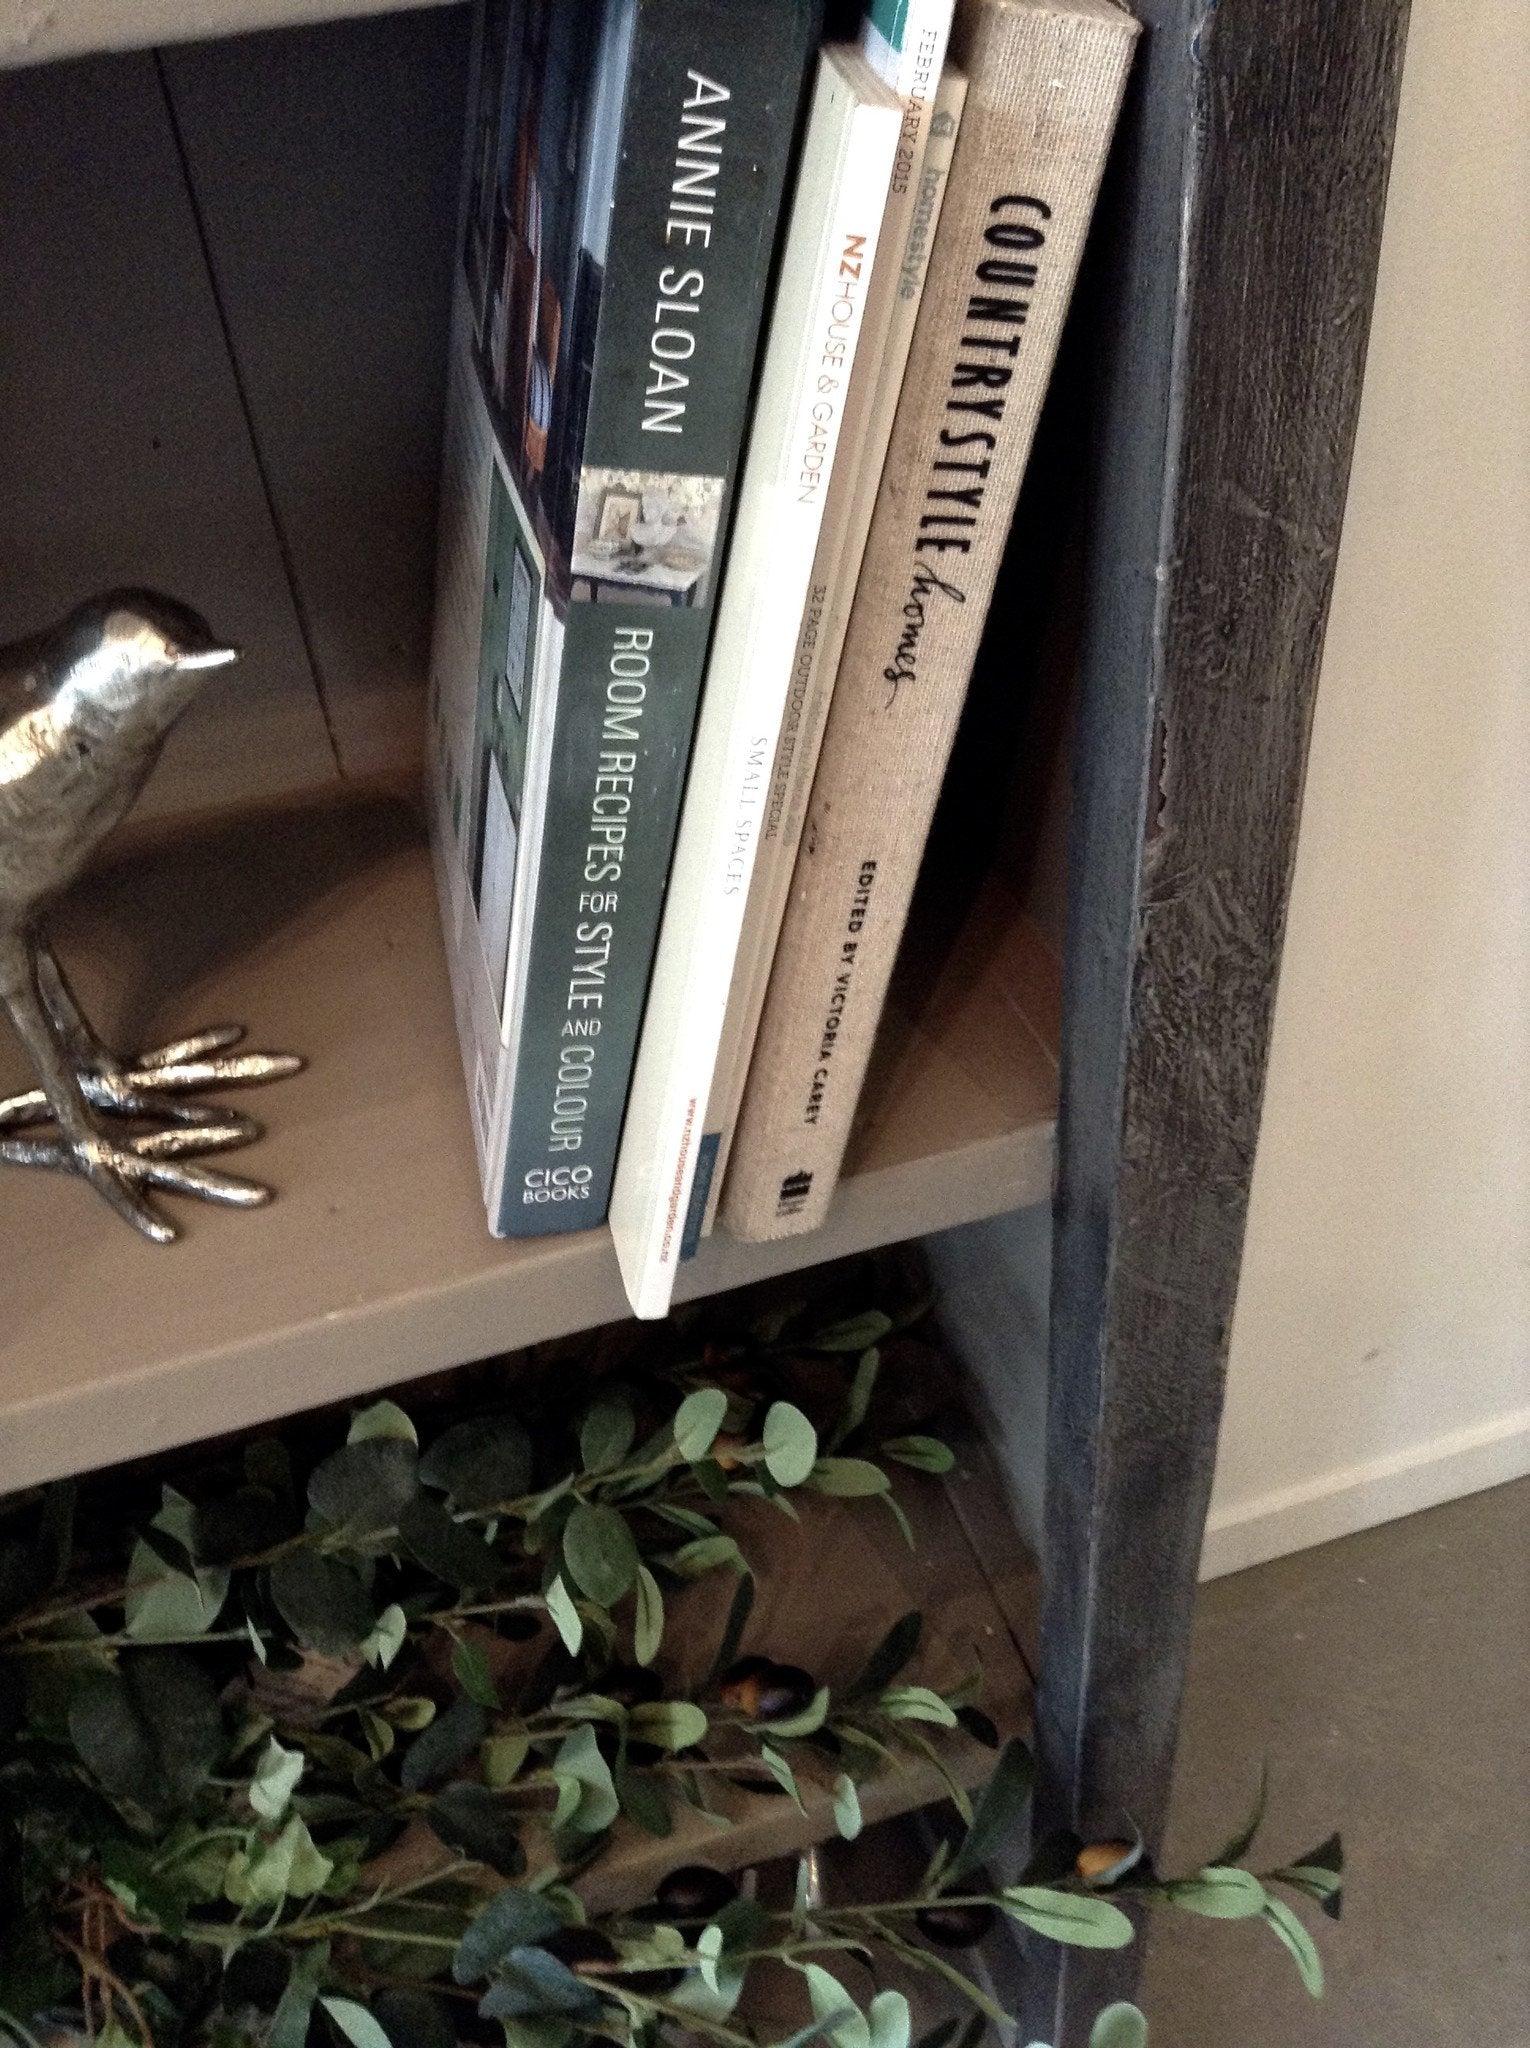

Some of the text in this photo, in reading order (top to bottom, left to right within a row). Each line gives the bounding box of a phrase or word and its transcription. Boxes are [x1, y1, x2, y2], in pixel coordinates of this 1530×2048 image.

[892, 28, 938, 195] FEBRUARY 2015
[641, 68, 731, 433] ANNIE SLOAN
[900, 168, 945, 300] homestyle
[817, 374, 840, 394] &
[797, 401, 834, 505] GARDEN
[884, 195, 1051, 706] COUNTRYSTYLE homes
[802, 608, 823, 650] PAGE
[812, 584, 827, 604] 32
[787, 653, 813, 733] OUTDOOR
[776, 736, 796, 780] STYLE
[724, 737, 768, 896] SMALL SPACES
[765, 782, 787, 840] SPECIAL
[548, 626, 654, 1152] ROOM RECIPES FOR STYLE AND COLOUR
[804, 860, 877, 1126] EDITED BY VICTORIA CAREY
[522, 1185, 591, 1204] BOOKS
[524, 1164, 593, 1188] CICO
